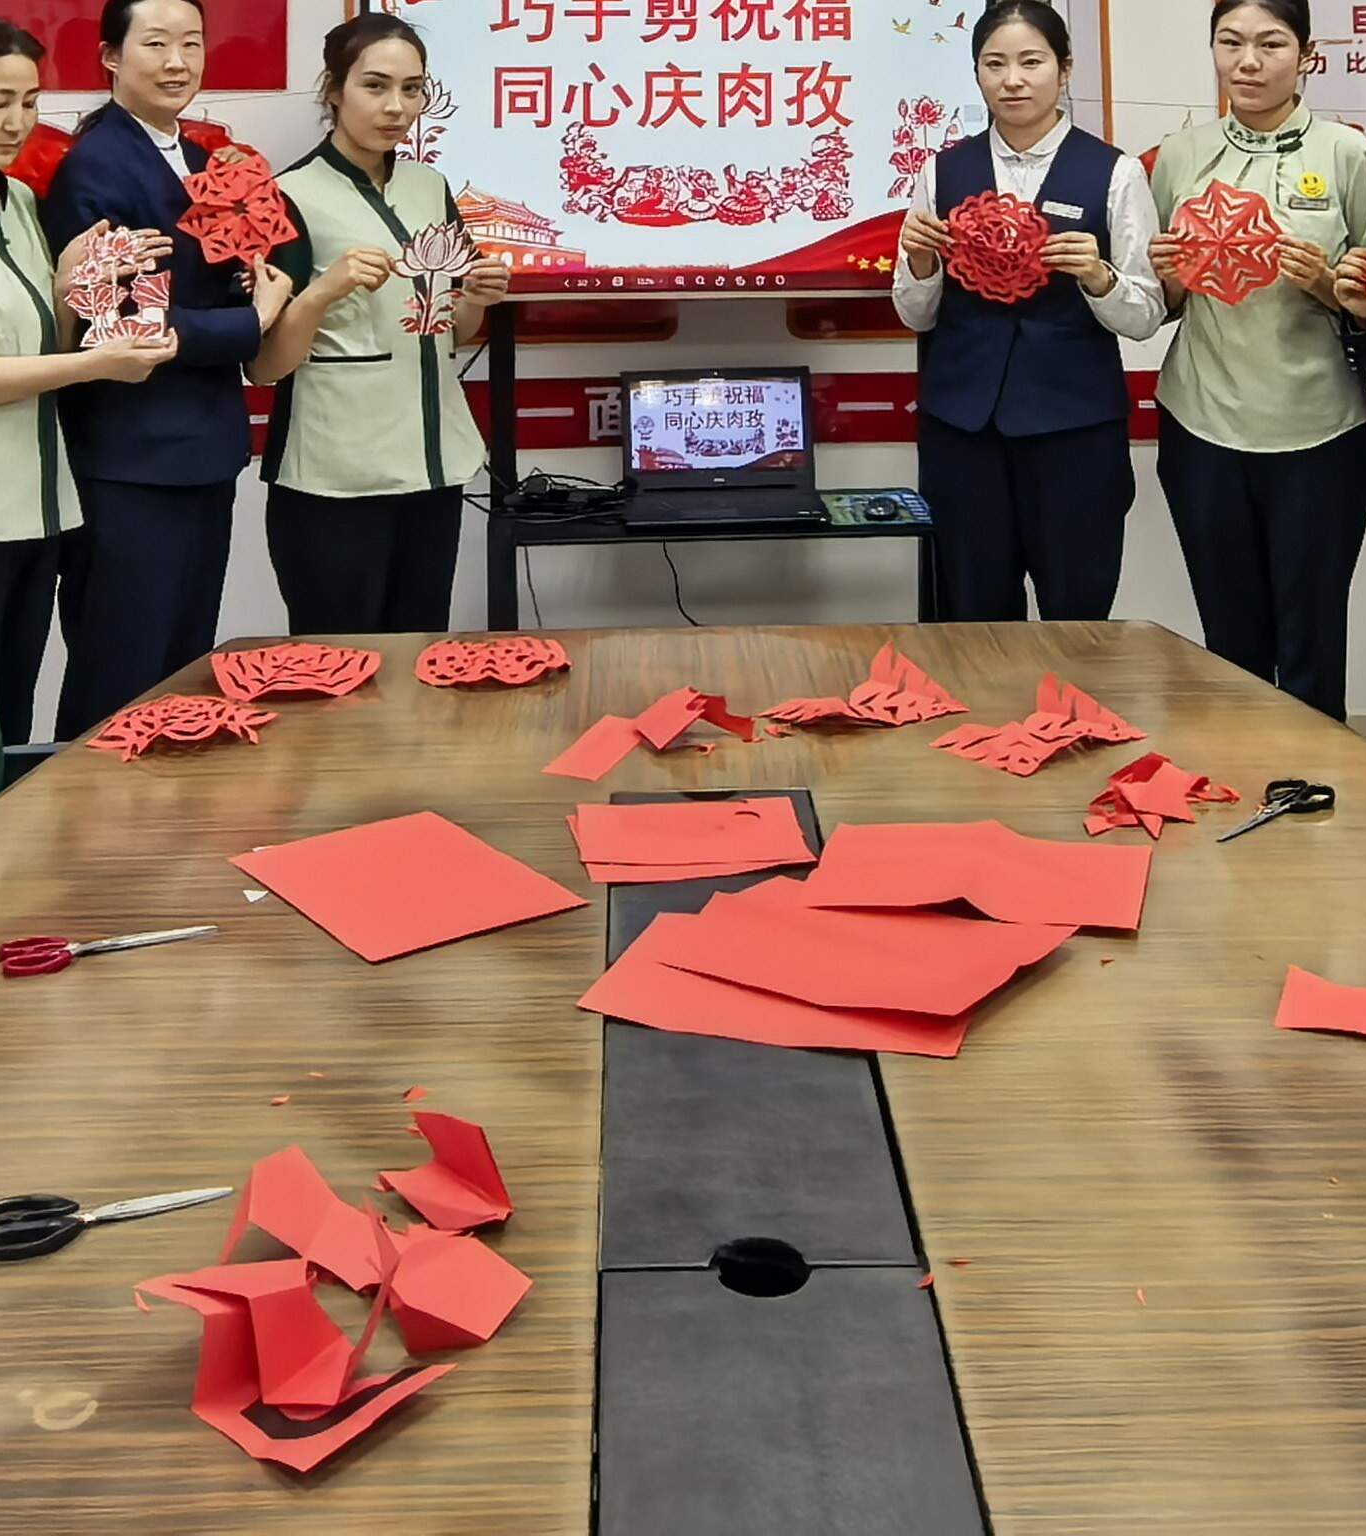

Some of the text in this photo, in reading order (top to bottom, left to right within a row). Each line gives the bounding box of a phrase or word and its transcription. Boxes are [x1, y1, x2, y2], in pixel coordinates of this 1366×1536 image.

[492, 61, 854, 130] 同心庆肉孜
[664, 385, 766, 406] 巧手祝福
[664, 409, 766, 431] 同心庆肉孜
